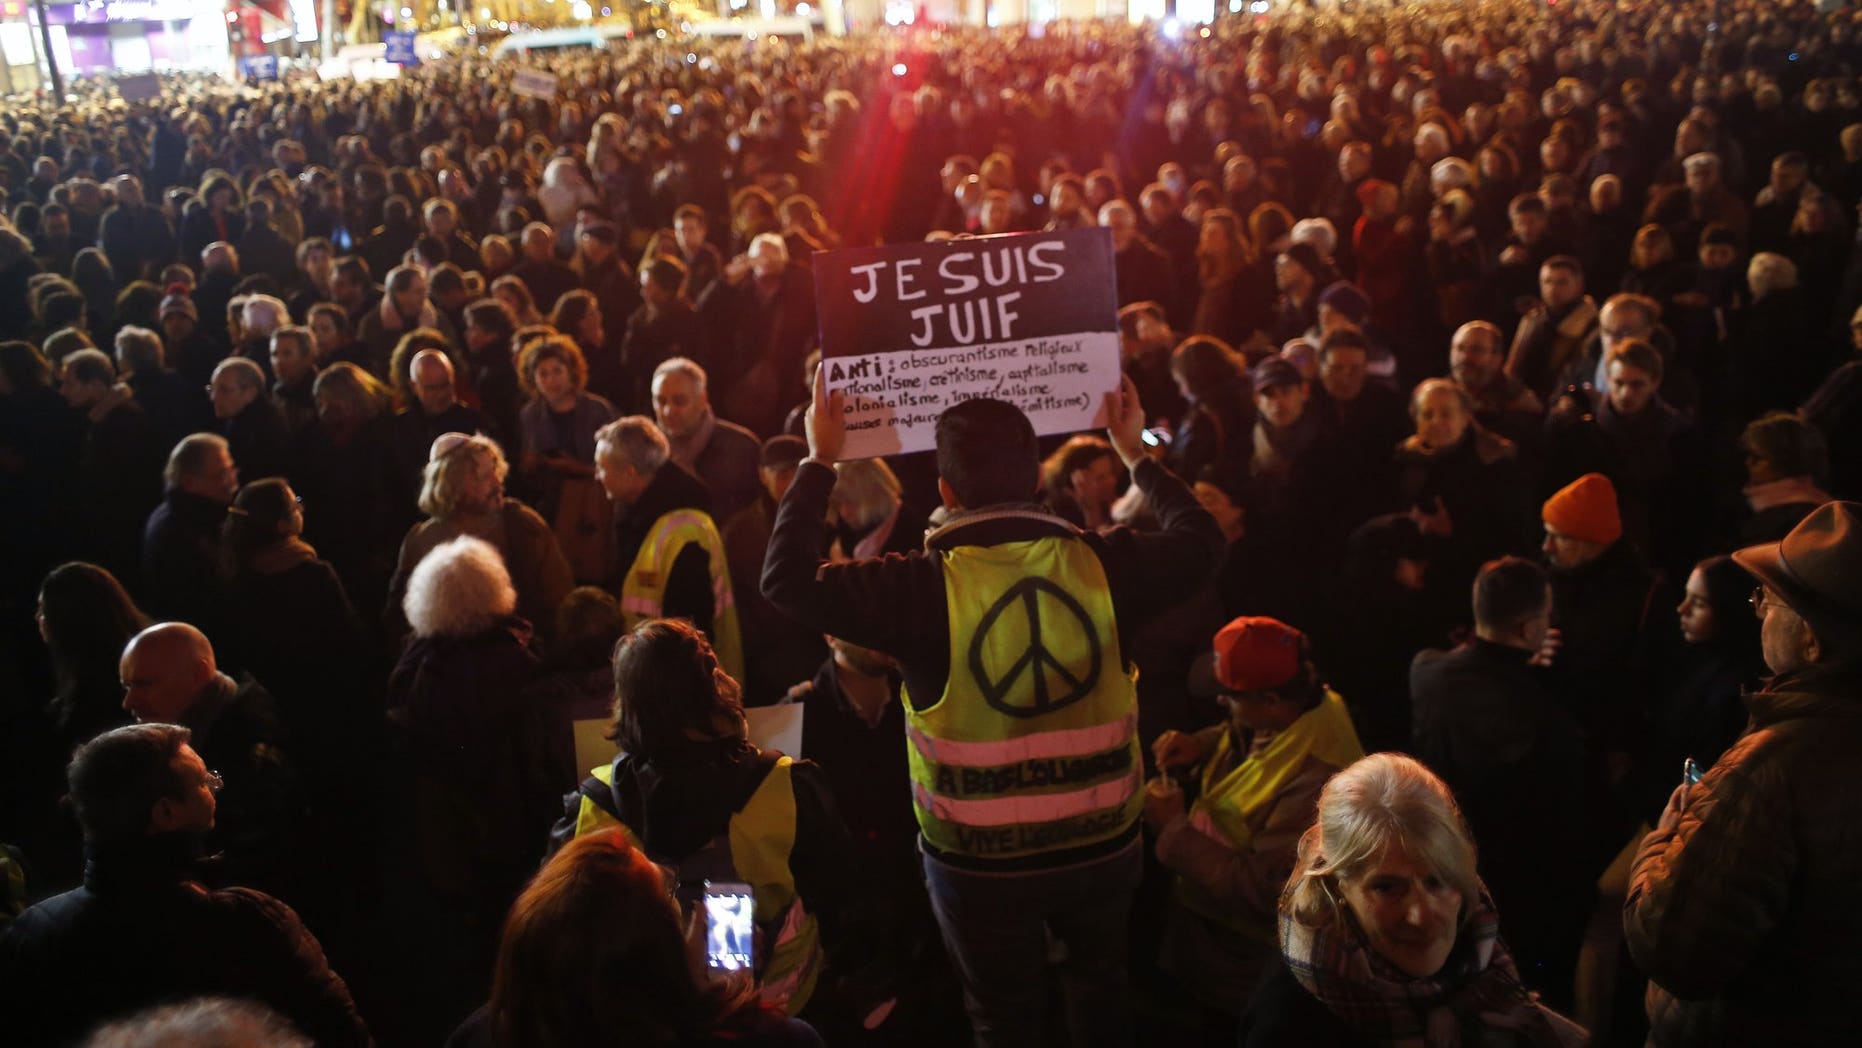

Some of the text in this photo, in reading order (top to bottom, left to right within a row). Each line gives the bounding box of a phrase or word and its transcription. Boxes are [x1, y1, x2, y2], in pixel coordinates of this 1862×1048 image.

[850, 240, 1066, 304] JE SUIS
[910, 291, 1022, 347] JUIF
[900, 345, 1018, 370] obscurantisme
[1025, 340, 1082, 360] religieux
[843, 391, 948, 413] olonialisme,
[936, 764, 957, 794] A
